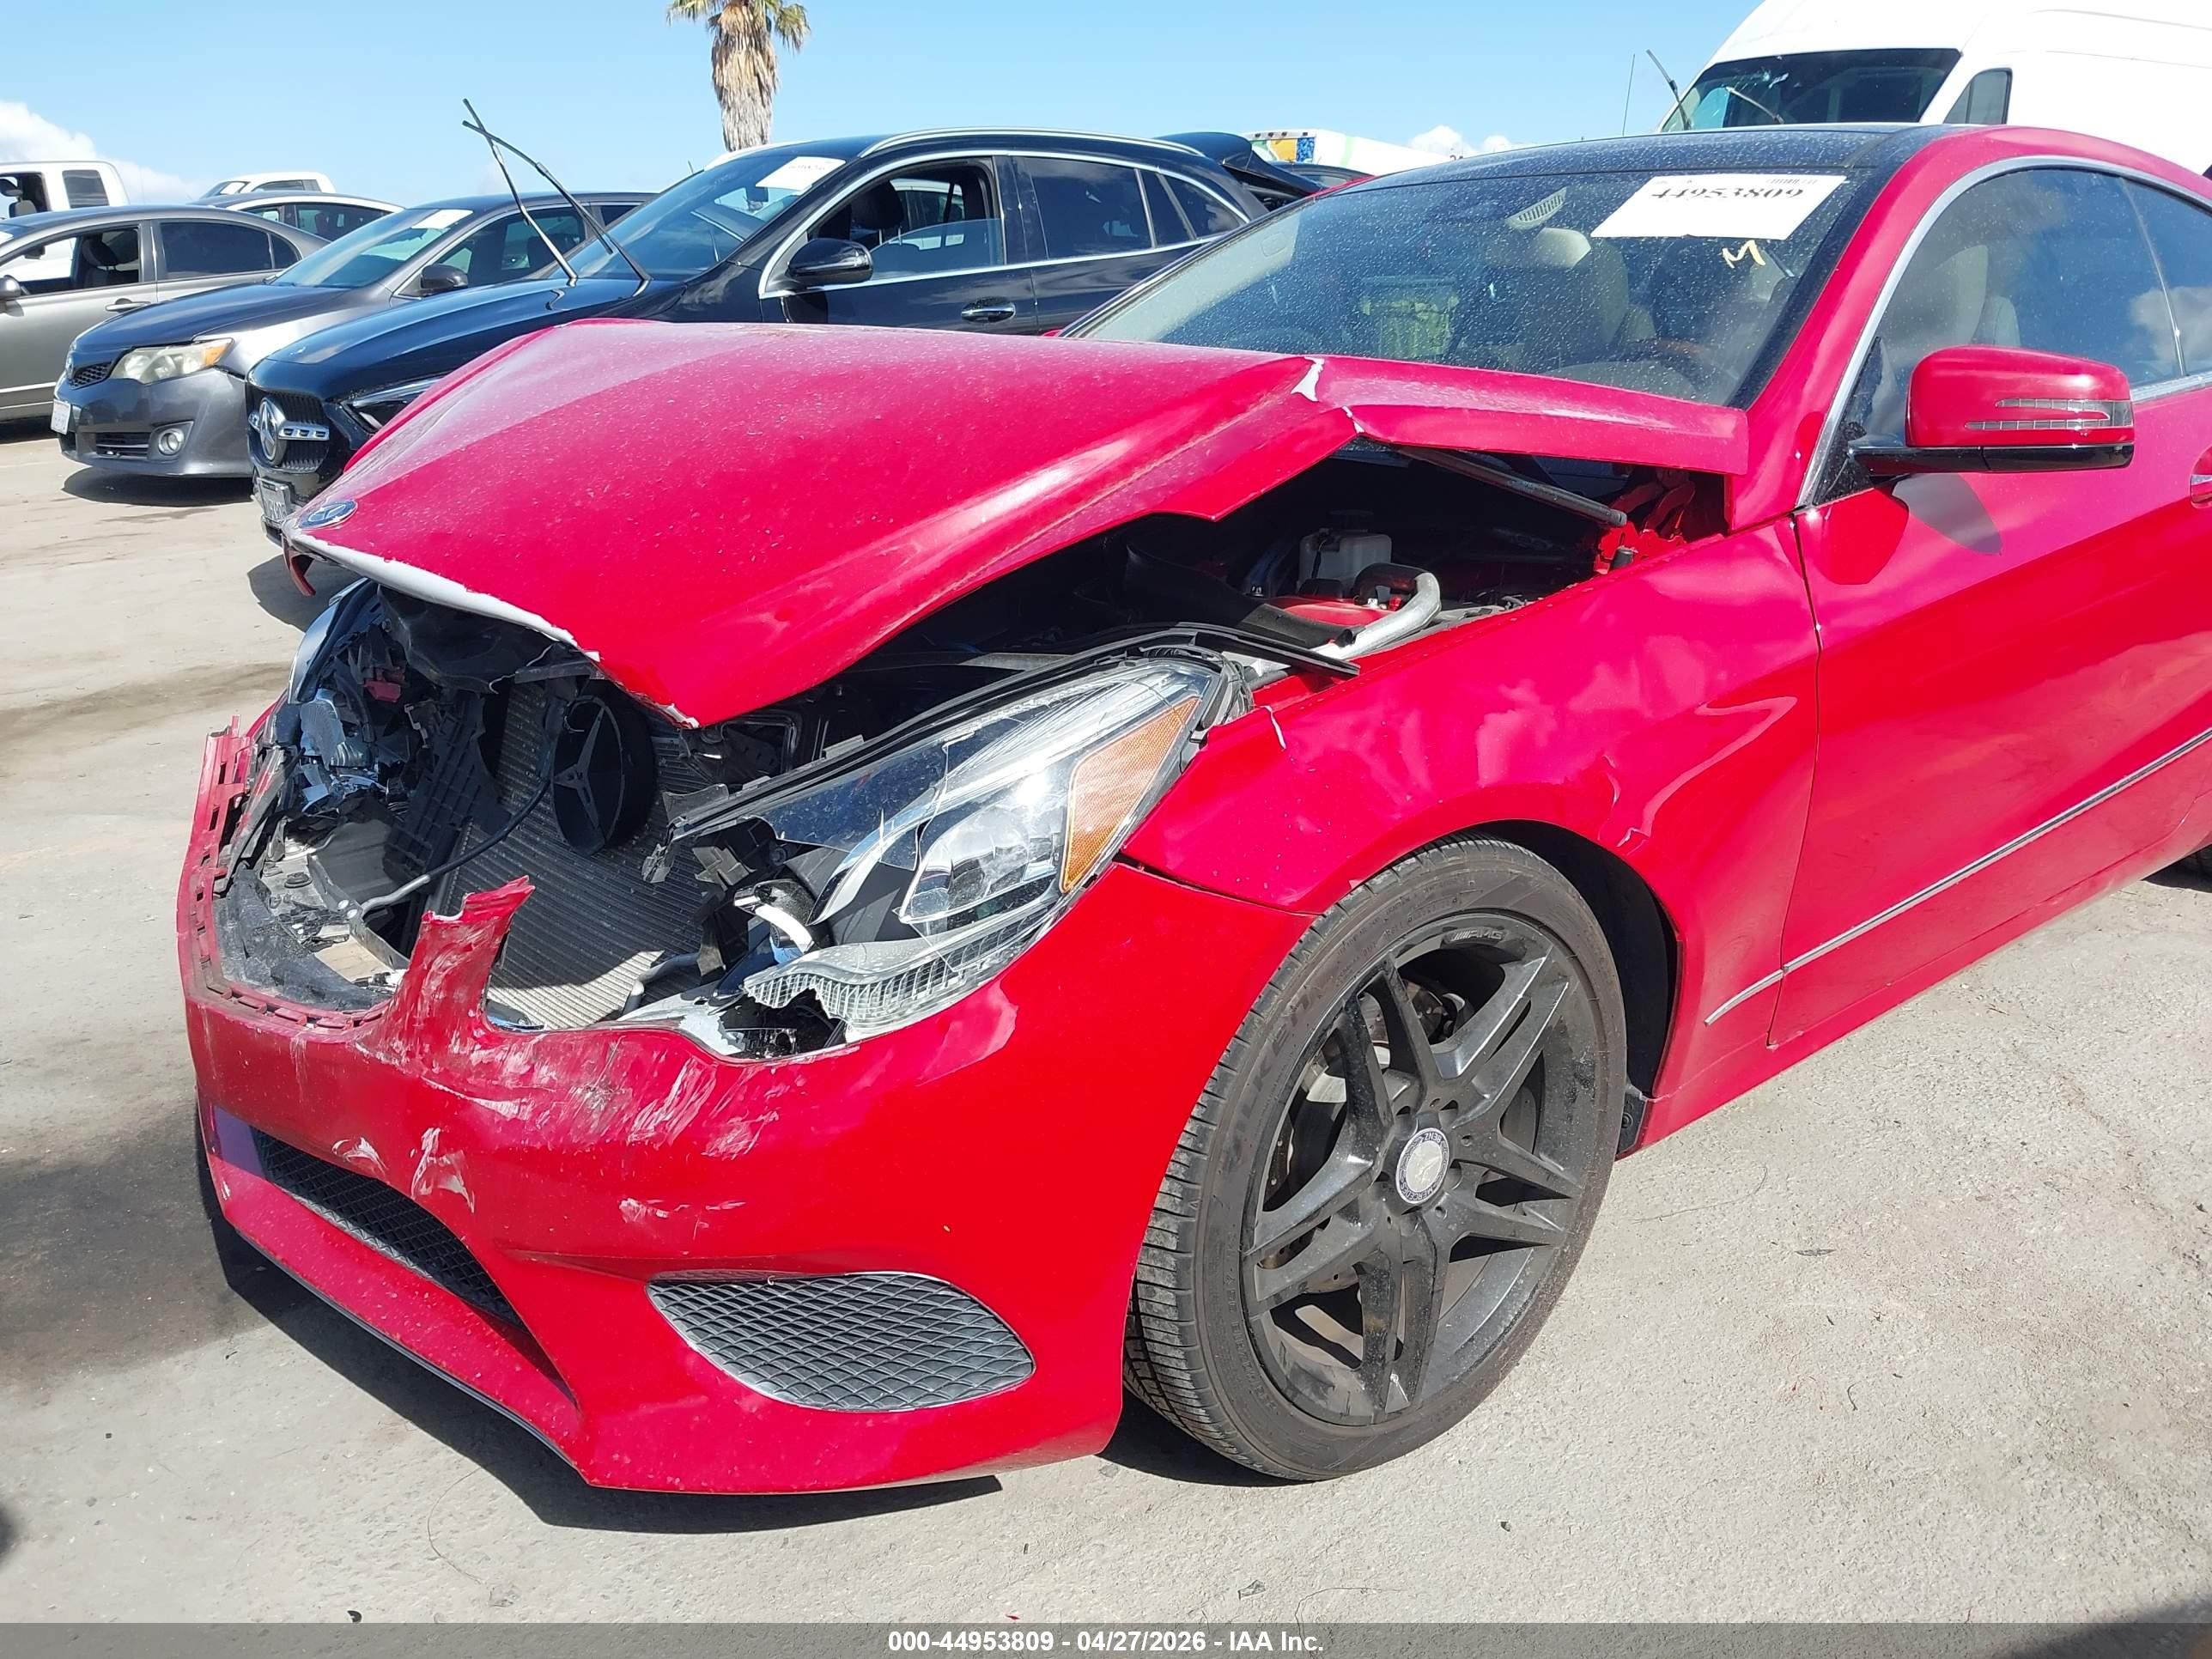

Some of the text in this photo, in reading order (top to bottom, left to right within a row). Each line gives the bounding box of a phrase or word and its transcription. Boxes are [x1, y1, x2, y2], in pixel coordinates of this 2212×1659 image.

[1651, 187, 1804, 198] 44953809
[1467, 928, 1504, 940] AMG
[1424, 1132, 1443, 1144] BENZ
[1400, 1181, 1434, 1201] MERCEDES
